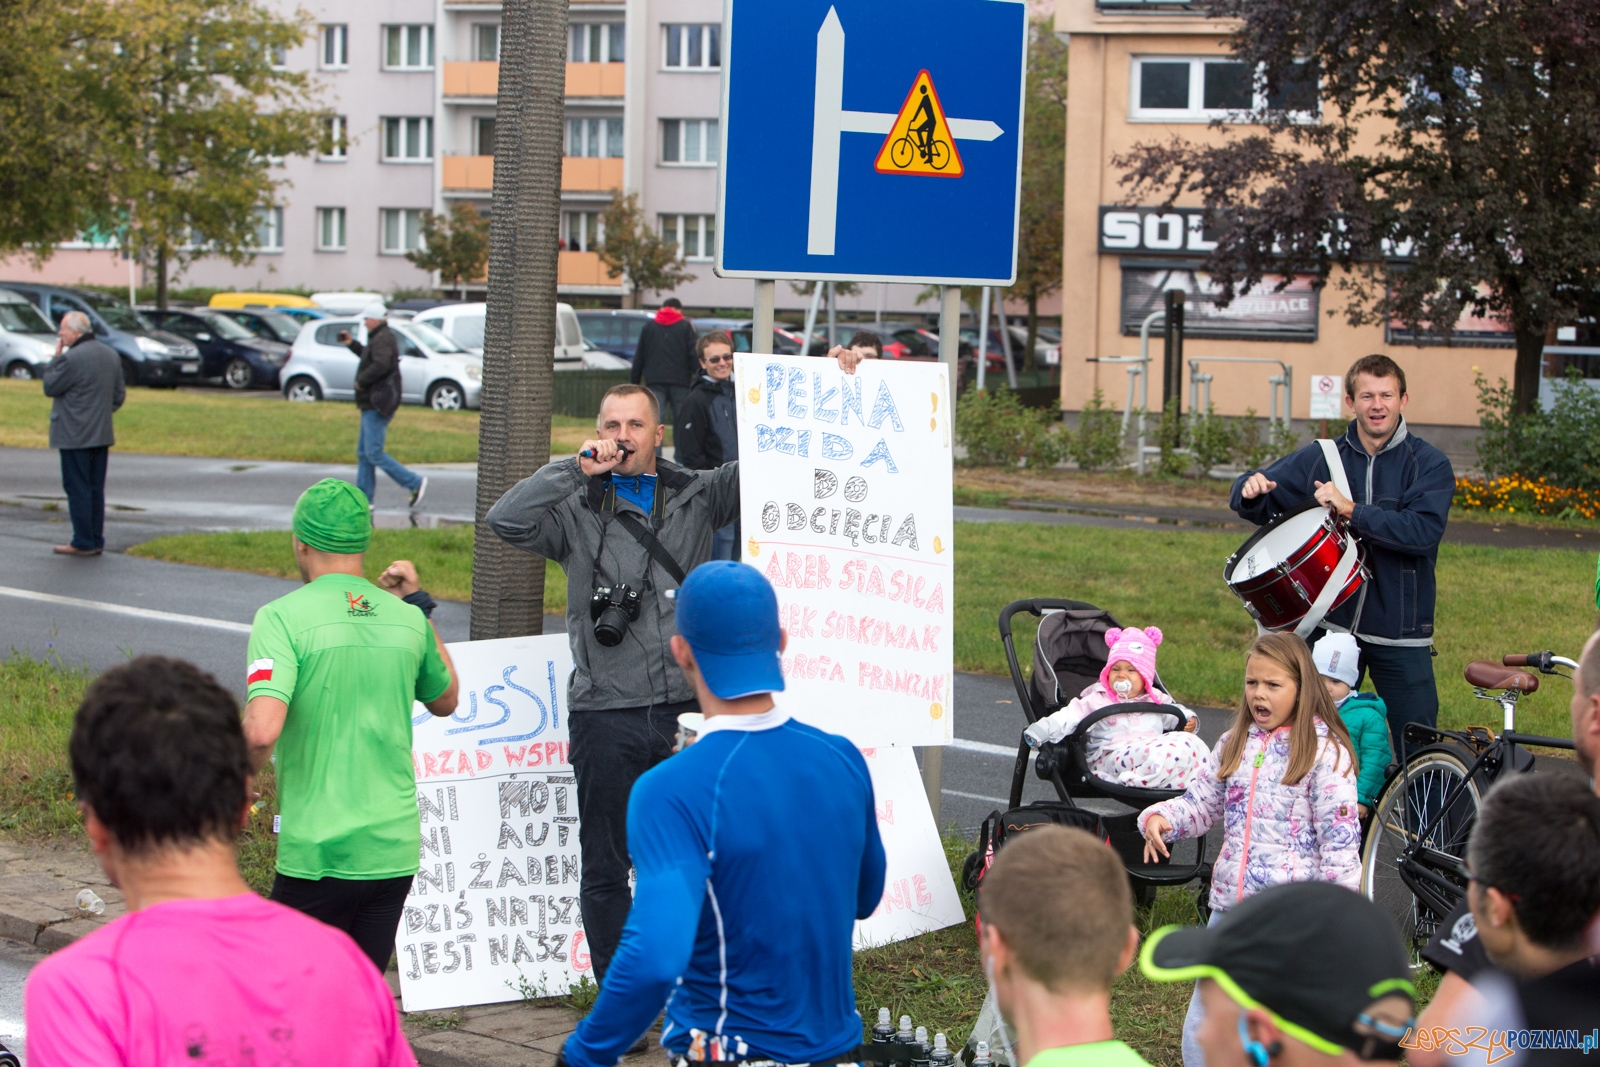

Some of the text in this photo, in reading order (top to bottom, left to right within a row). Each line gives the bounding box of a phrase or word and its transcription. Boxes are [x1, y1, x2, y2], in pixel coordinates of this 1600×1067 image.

[765, 363, 905, 432] PEŁNA
[814, 468, 868, 502] DO
[761, 501, 919, 551] ODCIĘCIA
[821, 610, 941, 652] SOBKOWIAK
[503, 741, 570, 767] WSPI
[408, 861, 456, 896] NI
[403, 890, 473, 936] DZIŚ
[403, 933, 477, 981] JEST
[488, 933, 568, 965] NASZ
